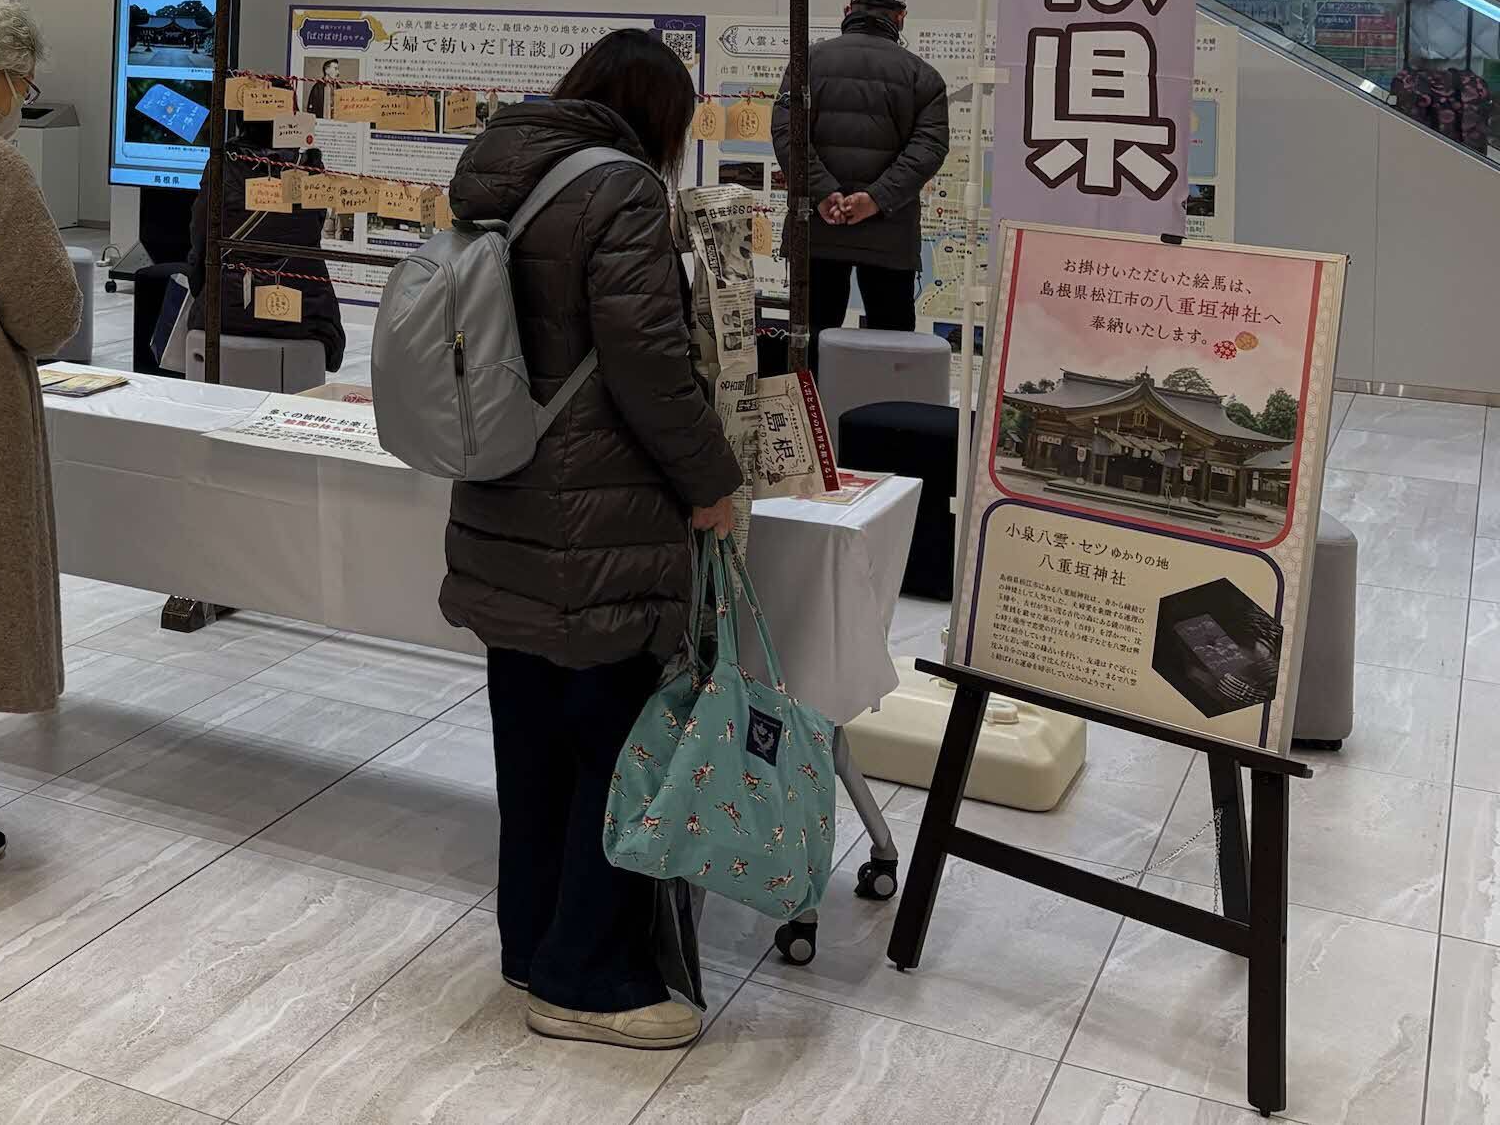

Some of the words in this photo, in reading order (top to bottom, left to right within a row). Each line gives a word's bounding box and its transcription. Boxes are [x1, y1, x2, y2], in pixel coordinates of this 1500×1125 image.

[154, 176, 180, 185] 島根県
[1064, 259, 1253, 295] お掛けいただいた絵馬は、
[1040, 280, 1282, 325] 島根県松江市の八重垣神社へ
[1091, 315, 1208, 346] 奉納いたします。
[1038, 554, 1127, 586] 八重垣神社
